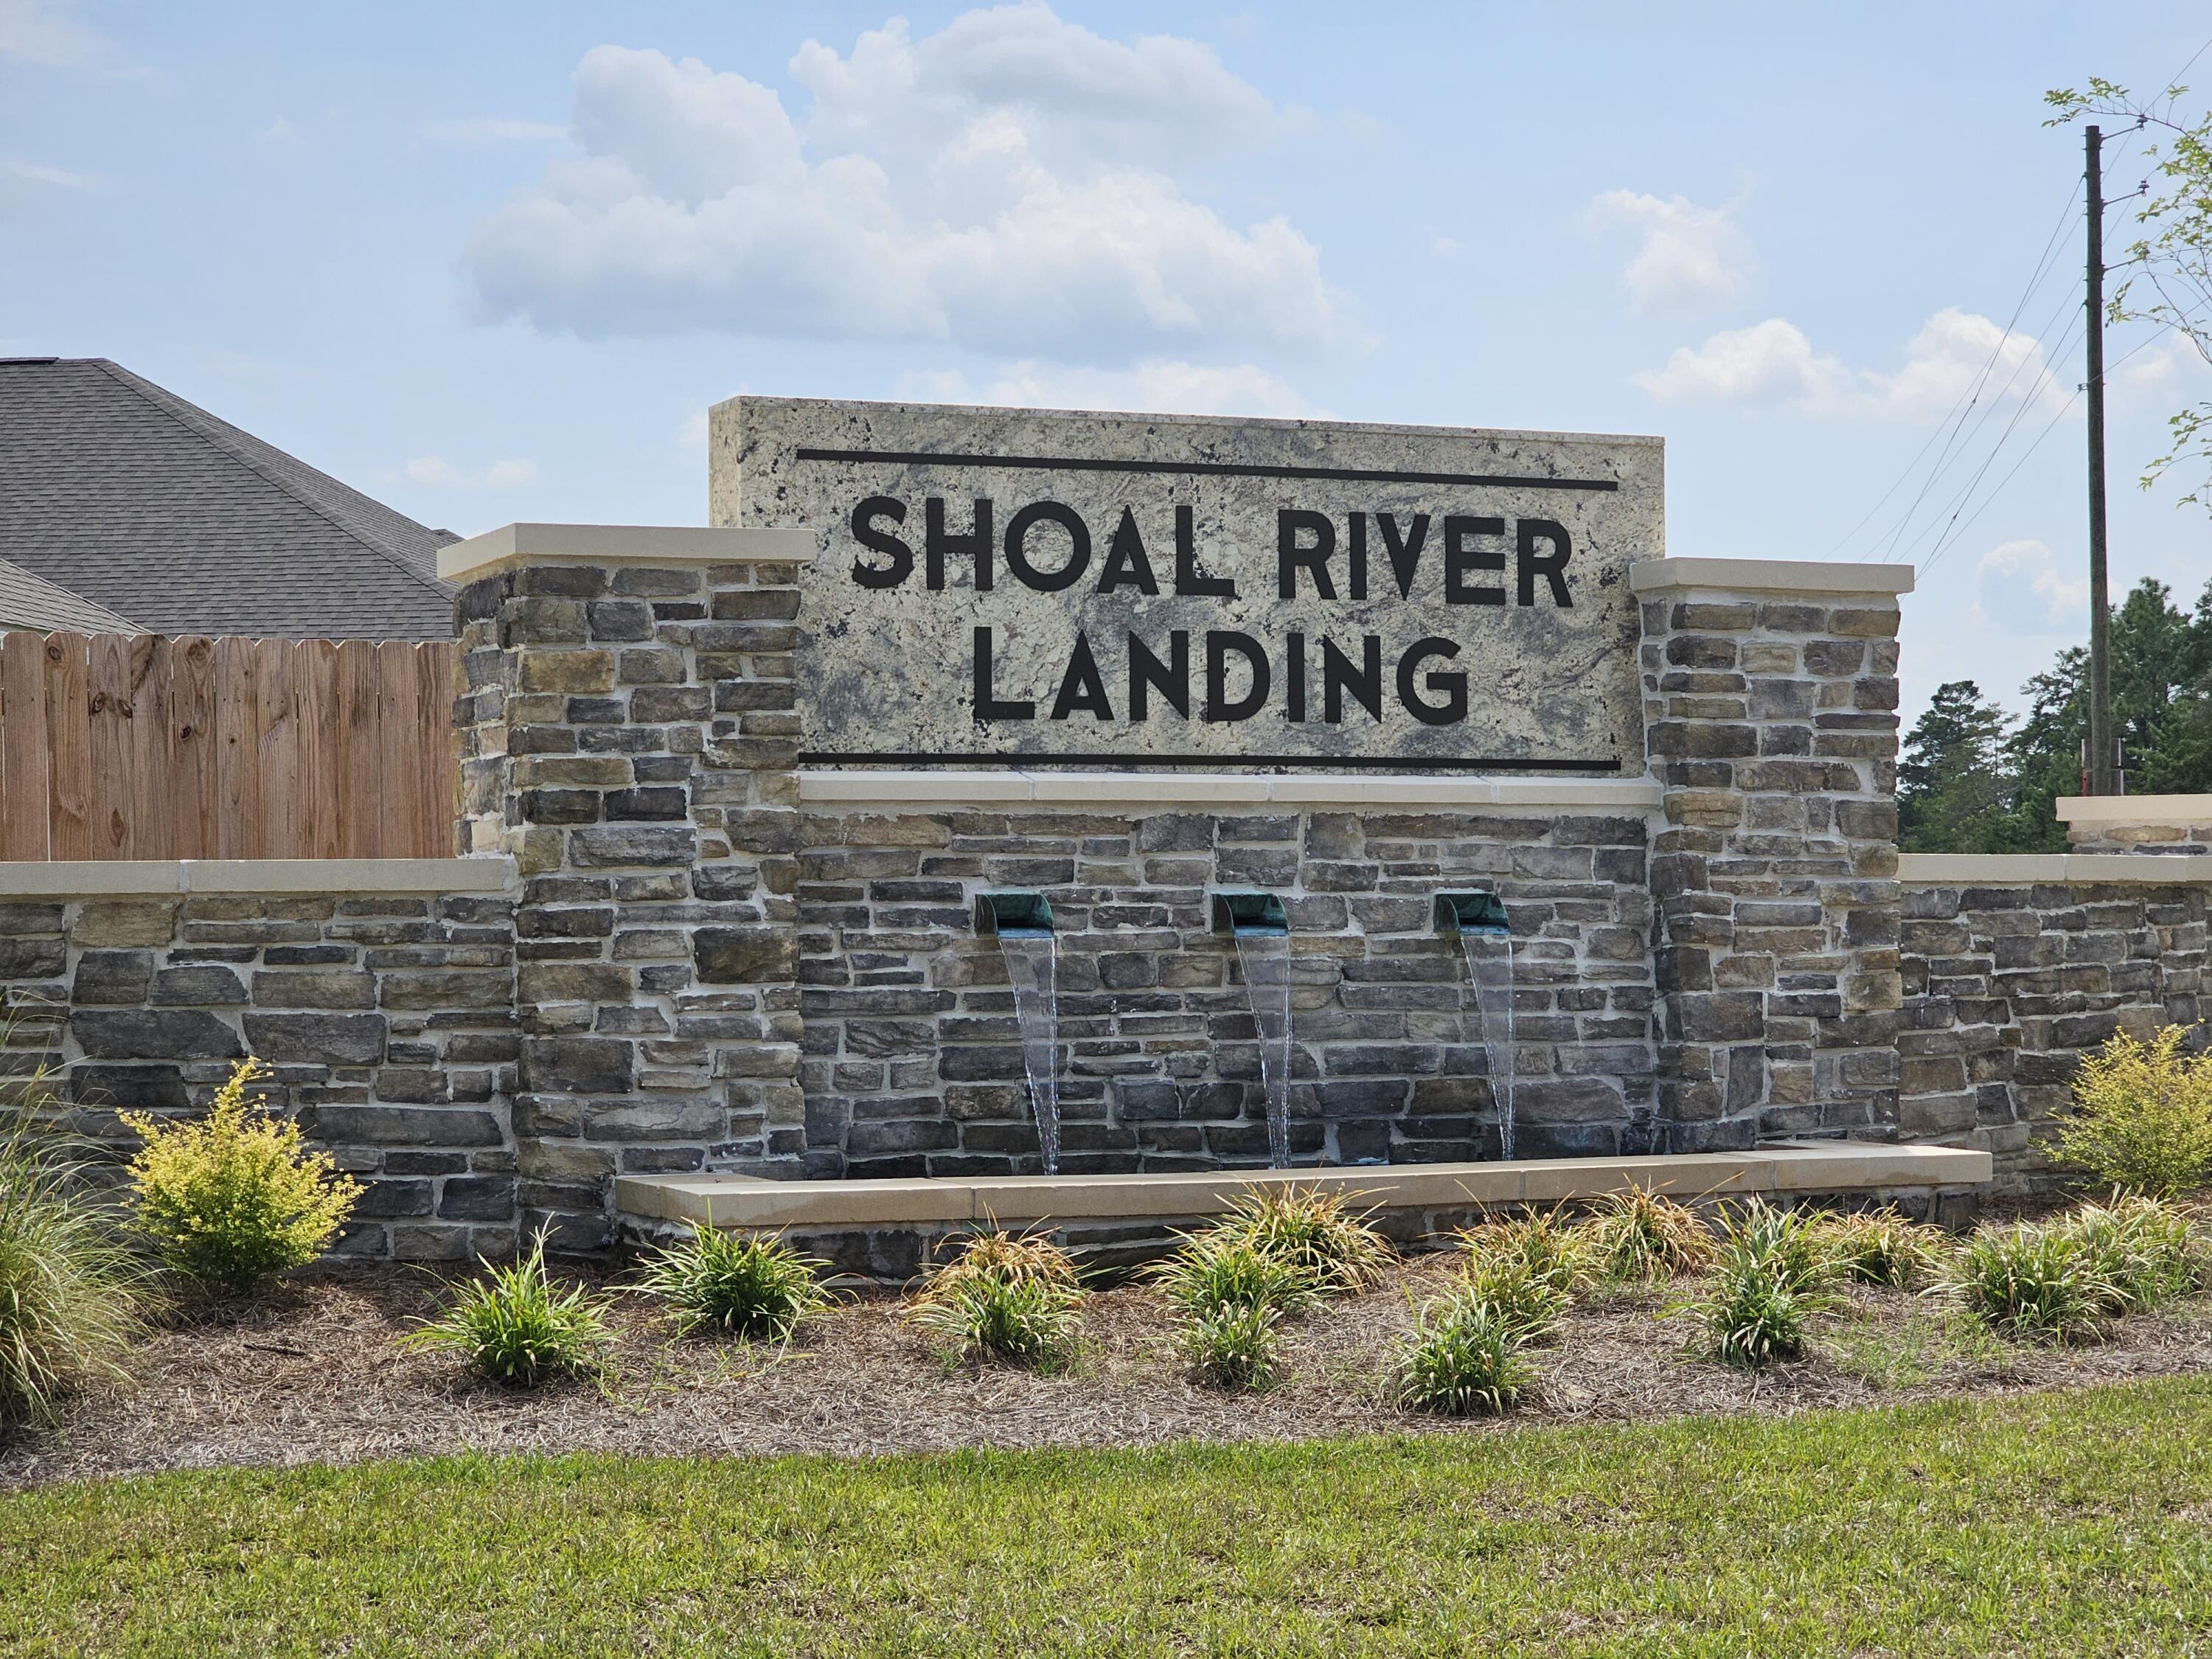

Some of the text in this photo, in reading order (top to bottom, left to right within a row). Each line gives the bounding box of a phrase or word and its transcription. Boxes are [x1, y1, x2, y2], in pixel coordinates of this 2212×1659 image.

[850, 496, 1573, 608] SHOAL RIVER
[973, 626, 1469, 726] LANDING
